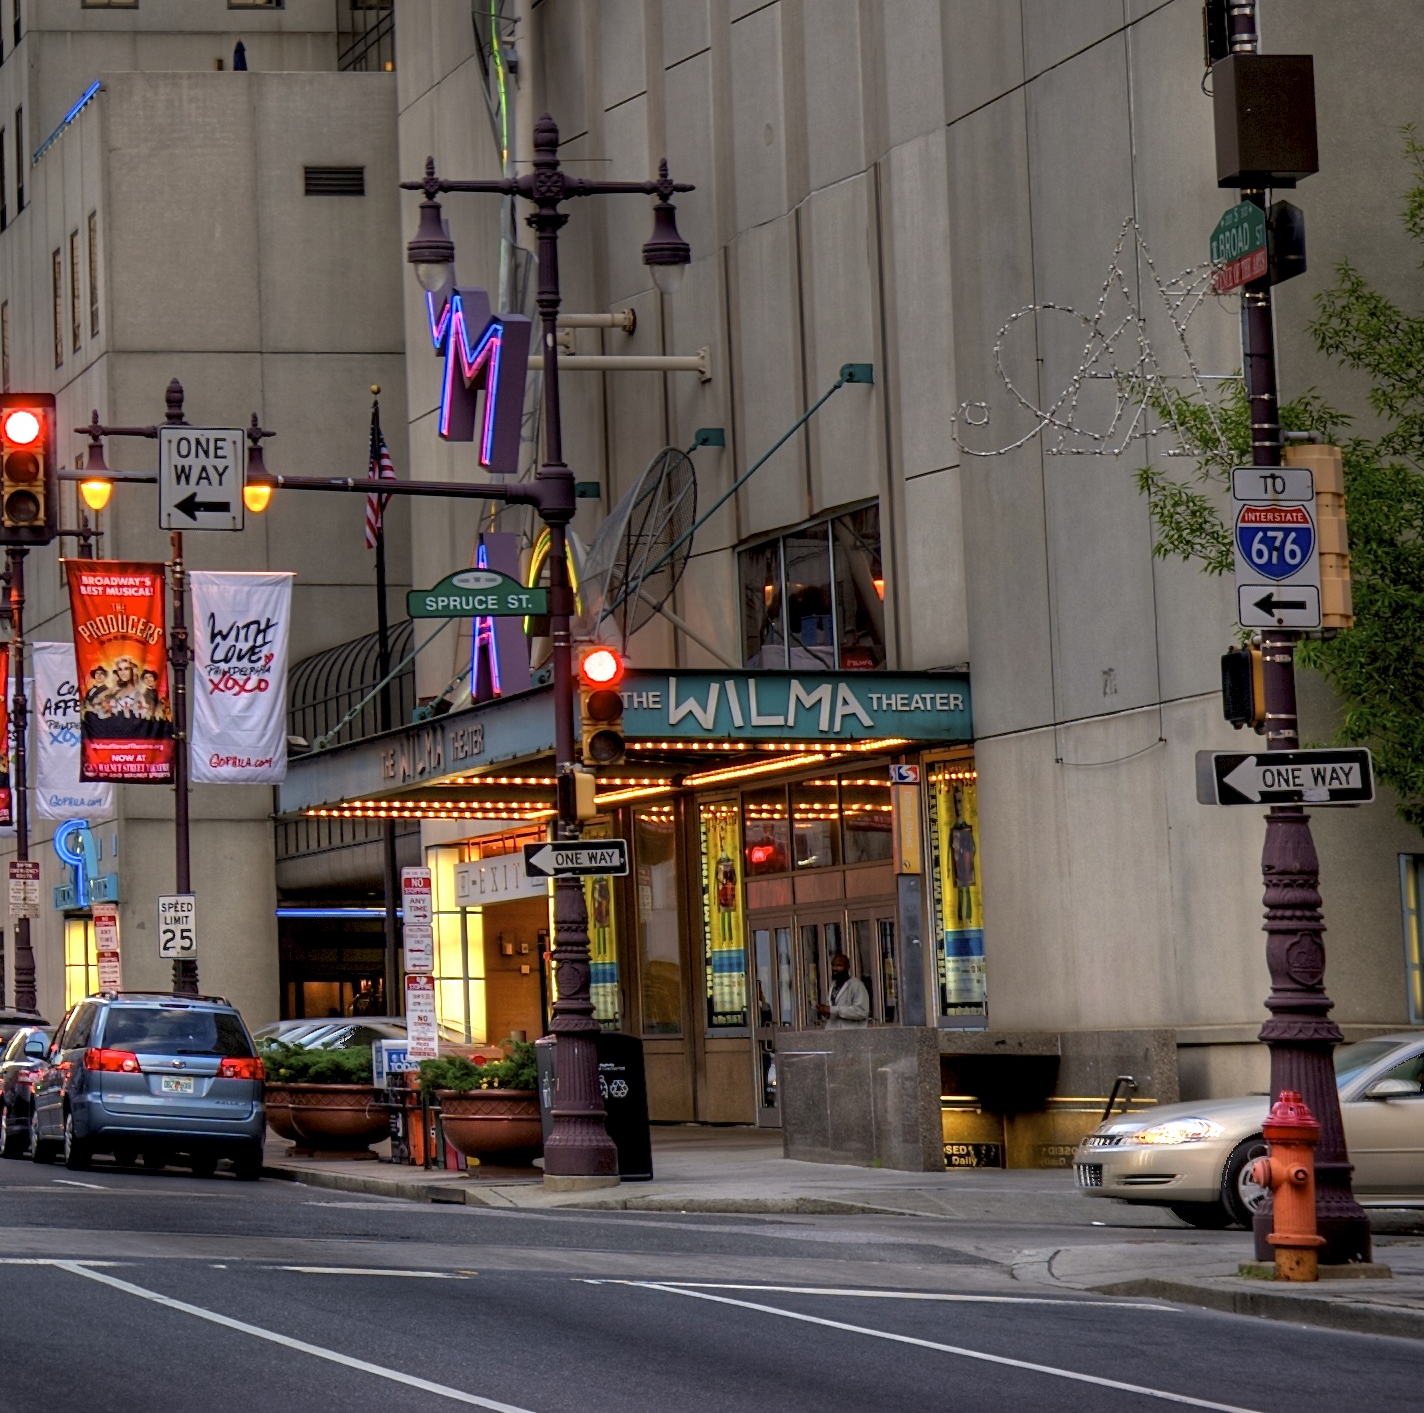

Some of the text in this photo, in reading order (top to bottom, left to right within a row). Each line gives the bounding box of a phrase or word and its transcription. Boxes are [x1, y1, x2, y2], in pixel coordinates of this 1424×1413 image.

[1218, 222, 1264, 260] BROAD ST
[176, 437, 228, 459] ONE
[174, 464, 229, 486] WAY
[1259, 474, 1287, 495] TO
[1244, 511, 1305, 523] INTERSTATE
[1251, 531, 1302, 565] 676
[80, 586, 154, 596] BEST MUSICAL!
[82, 575, 151, 586] BROADWAY'S
[111, 603, 126, 612] THE
[425, 594, 533, 611] SPRUCE ST.
[77, 614, 163, 645] PRODUCERS
[208, 611, 278, 645] WITH
[209, 644, 263, 665] LOVE
[208, 673, 269, 695] XOXO
[621, 676, 964, 733] THE WILMA THEATER
[111, 754, 146, 762] NOW AT
[380, 723, 485, 783] THE WILMA THEATER
[1262, 765, 1354, 789] ONE WAY
[555, 851, 615, 866] ONE WAY
[411, 877, 424, 887] NO
[479, 862, 521, 894] EXIT
[161, 902, 193, 913] SPEED
[409, 897, 426, 905] ANY
[409, 905, 428, 913] TIME
[164, 915, 190, 926] LIMIT
[162, 928, 194, 951] 25
[951, 1156, 978, 1167] Daily
